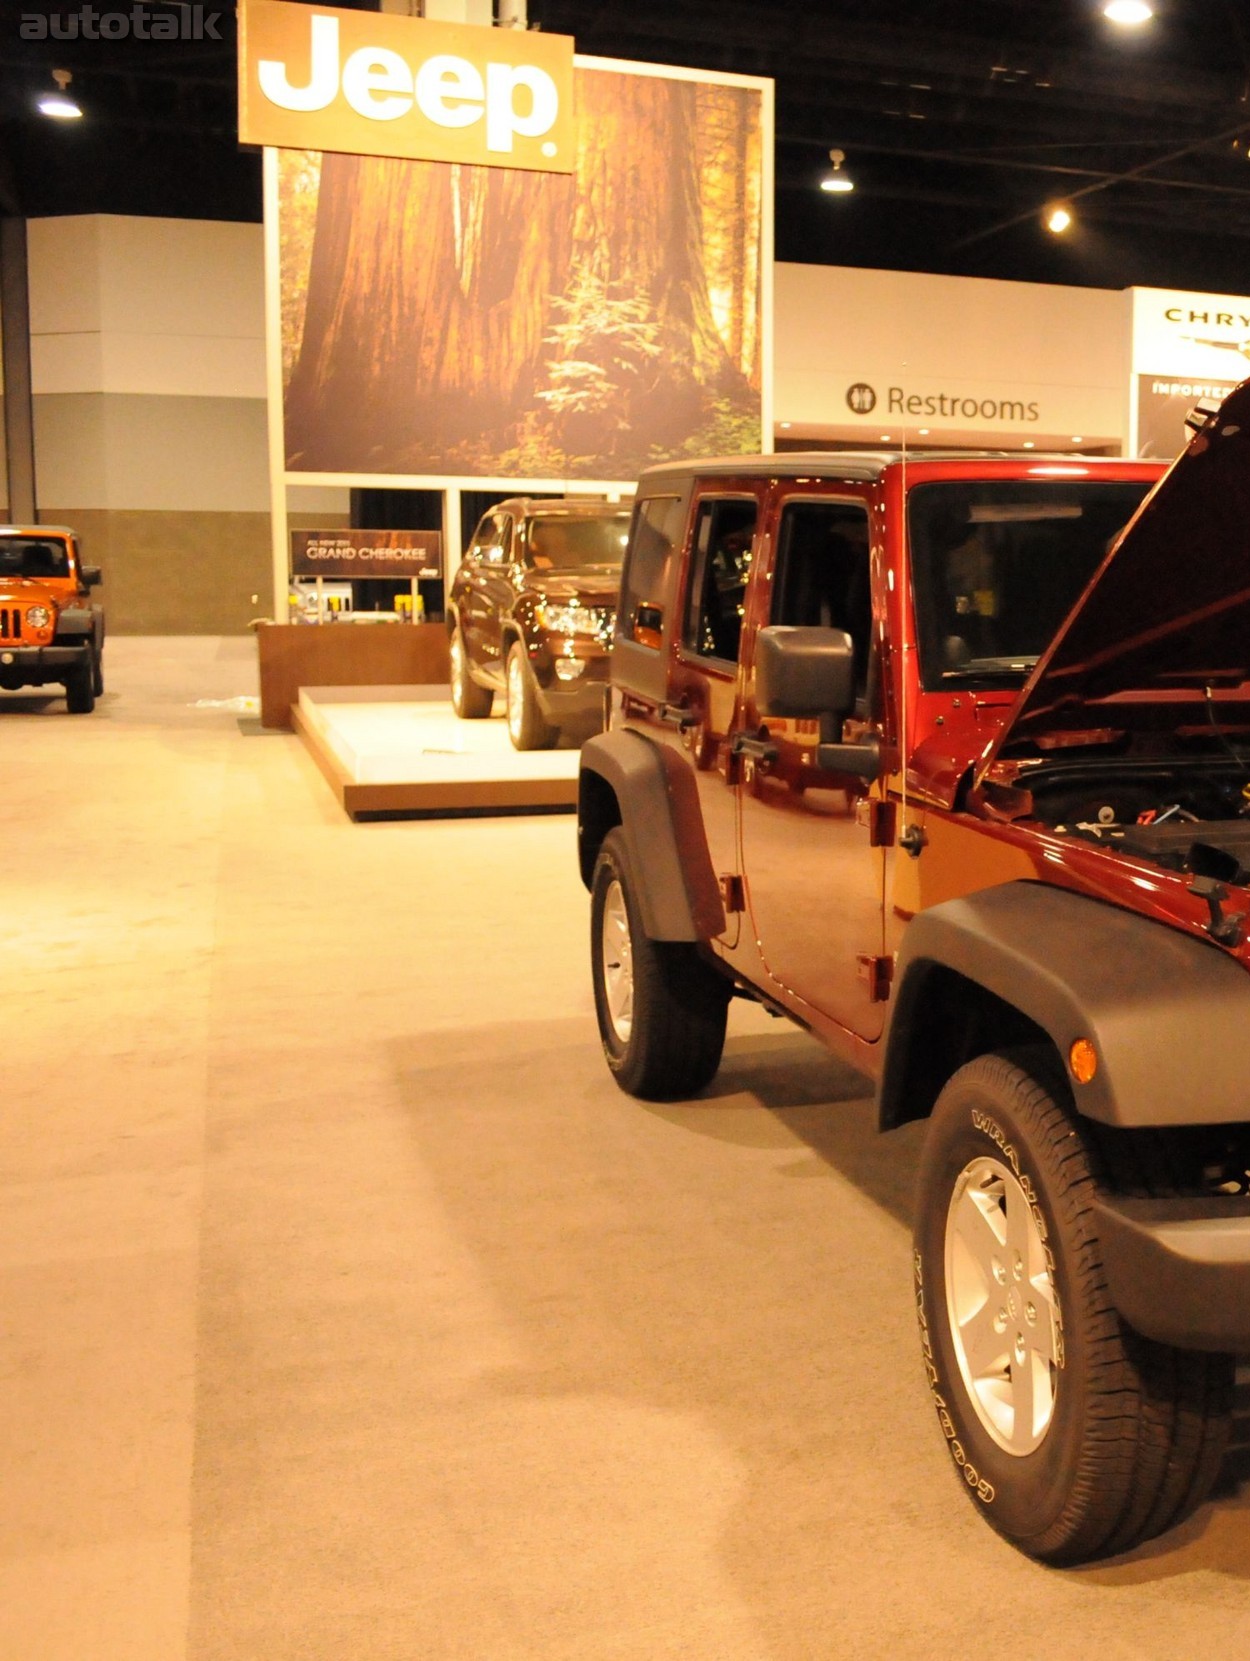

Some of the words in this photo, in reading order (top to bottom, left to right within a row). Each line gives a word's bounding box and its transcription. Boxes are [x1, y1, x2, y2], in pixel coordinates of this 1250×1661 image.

[258, 15, 558, 153] Jeep
[888, 387, 1039, 422] Restrooms
[306, 547, 357, 560] GRAND
[358, 547, 426, 561] CHEROKEE
